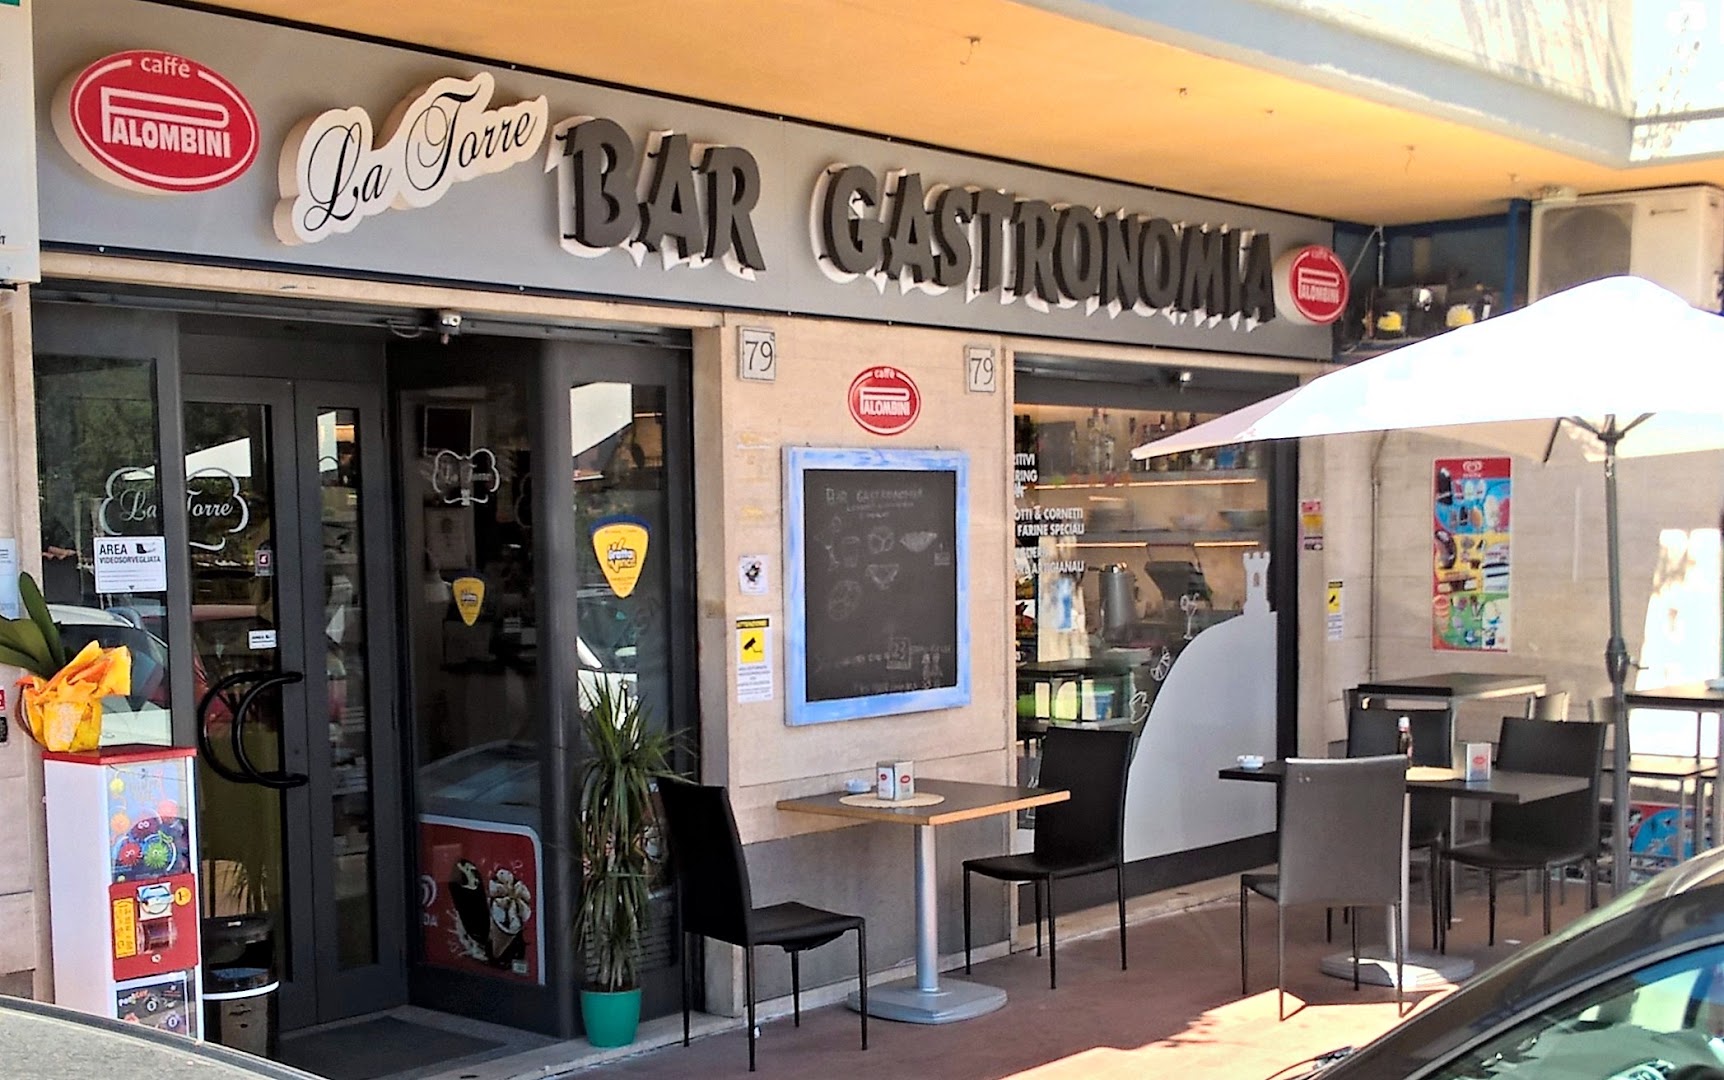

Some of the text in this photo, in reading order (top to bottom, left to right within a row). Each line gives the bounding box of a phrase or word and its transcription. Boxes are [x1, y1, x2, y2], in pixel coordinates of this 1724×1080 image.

[140, 55, 191, 79] caffè
[101, 85, 232, 159] PALOMBINI
[303, 91, 538, 232] La Torre
[560, 116, 1276, 325] BAR GASTRONOMIA
[745, 340, 773, 372] 79
[873, 367, 896, 379] caffè
[971, 357, 994, 385] 79
[859, 386, 911, 416] PALOMBINI
[120, 488, 157, 521] La
[1034, 507, 1041, 519] &
[1043, 507, 1083, 519] CORNETTI
[1017, 522, 1085, 536] FARINE SPECIALI
[100, 543, 128, 555] AREA
[100, 556, 161, 564] VIDEOSORVEGLIATA
